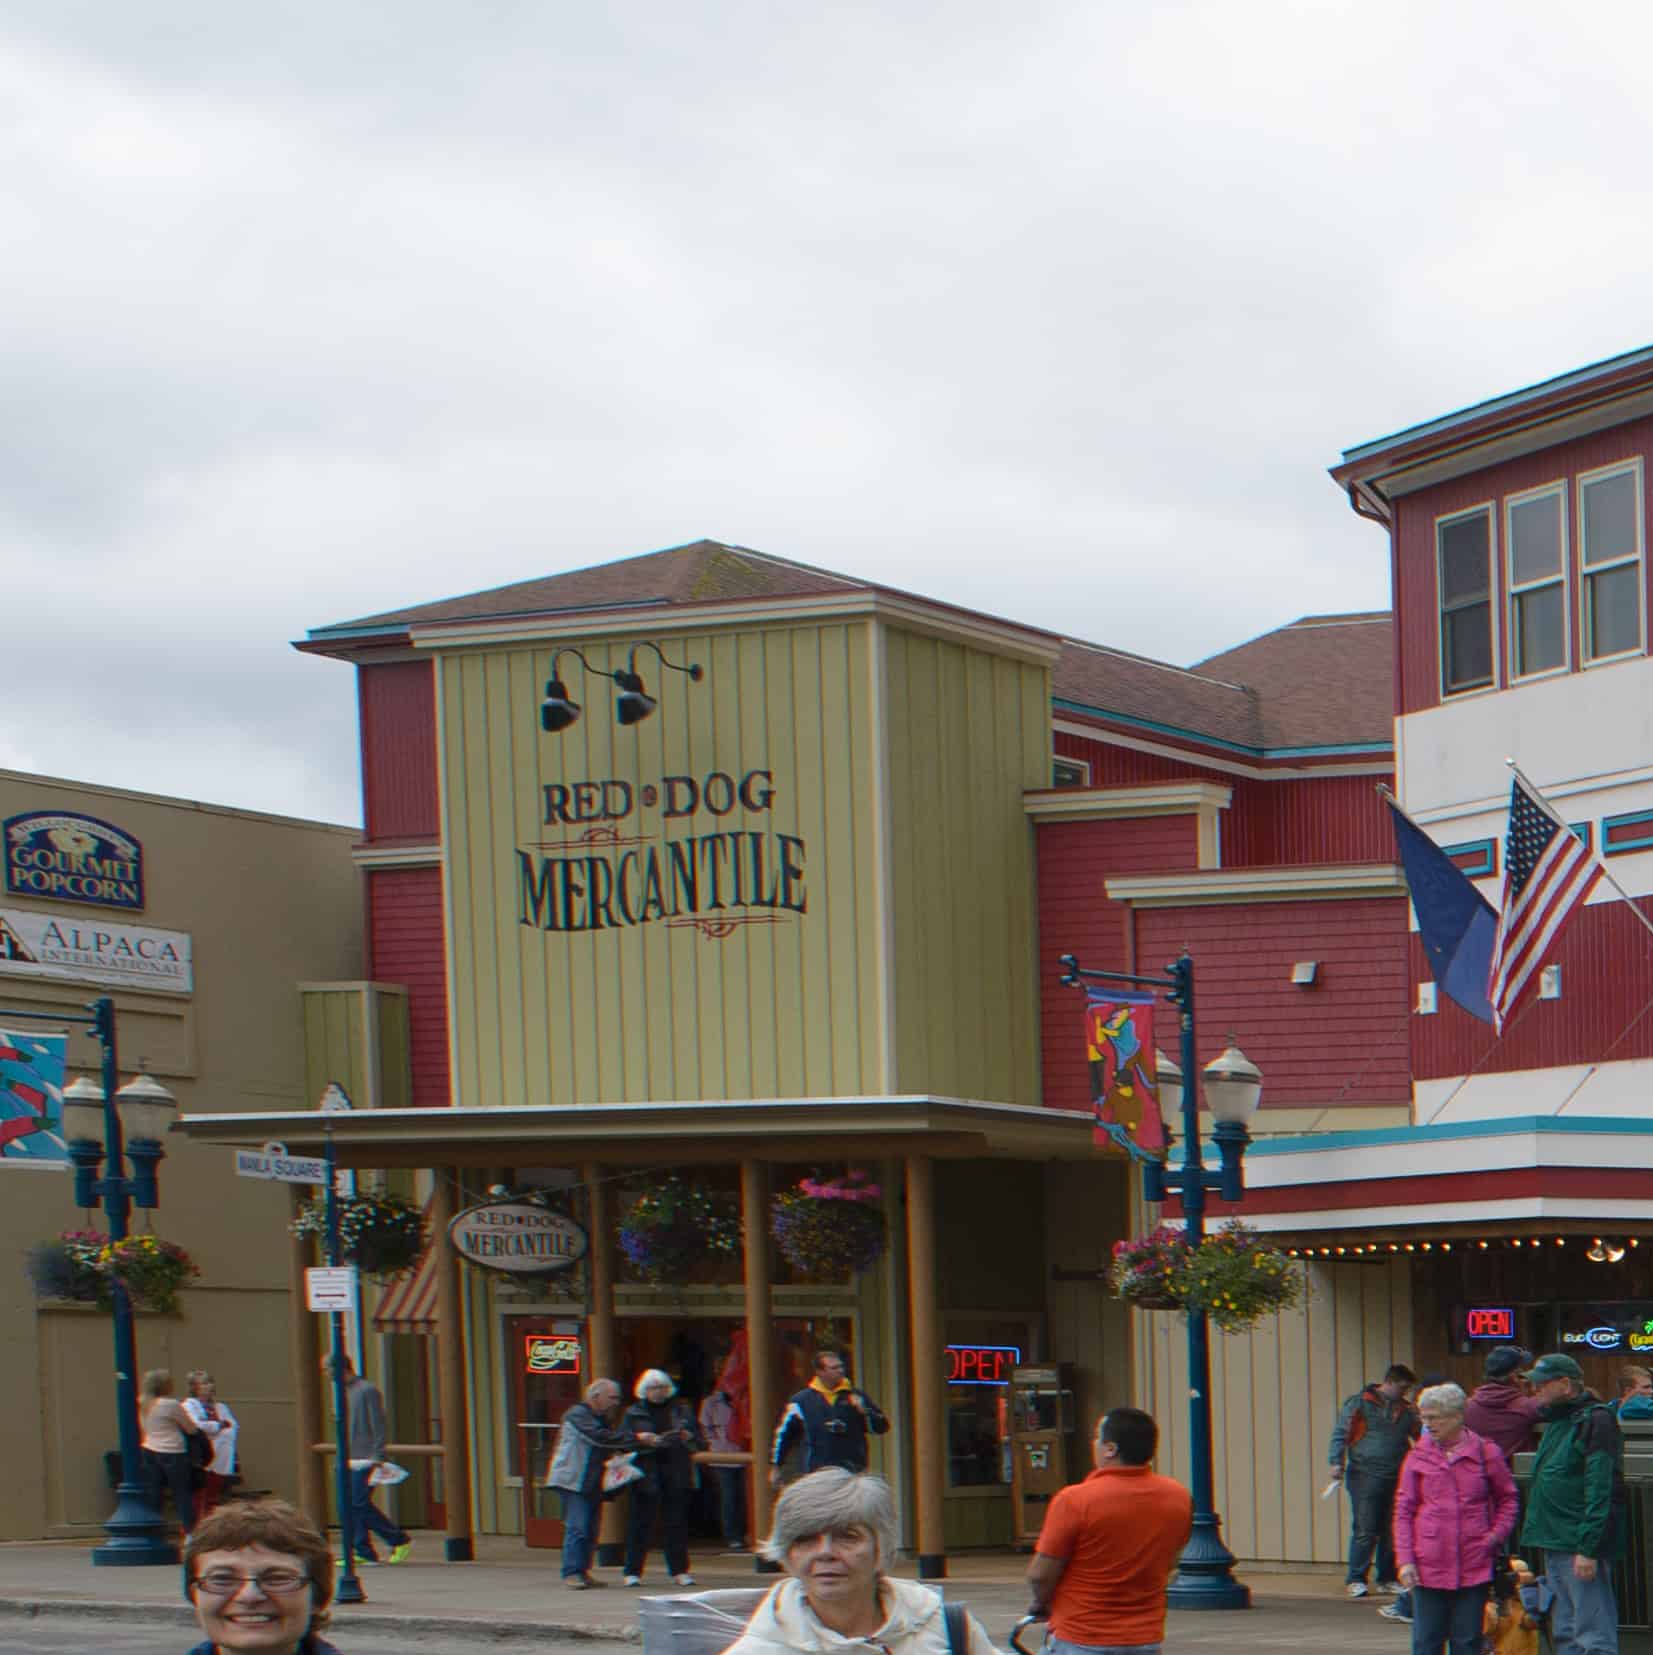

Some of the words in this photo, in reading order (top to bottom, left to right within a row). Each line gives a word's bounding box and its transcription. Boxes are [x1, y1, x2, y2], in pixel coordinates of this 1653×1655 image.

[543, 780, 633, 825] RED
[661, 770, 776, 819] DOG
[11, 846, 137, 881] GOURMET
[12, 867, 138, 902] POPCORN
[514, 831, 808, 932] MERCANTILE
[43, 920, 180, 962] ALPACA
[42, 949, 184, 975] INTERNATIONAL
[275, 1159, 321, 1178] SQUARE
[475, 1212, 514, 1226] RED
[527, 1214, 566, 1229] DOG
[463, 1231, 578, 1257] MERCANTILE
[1470, 1311, 1511, 1336] OPEN
[944, 1348, 1016, 1381] OPEN
